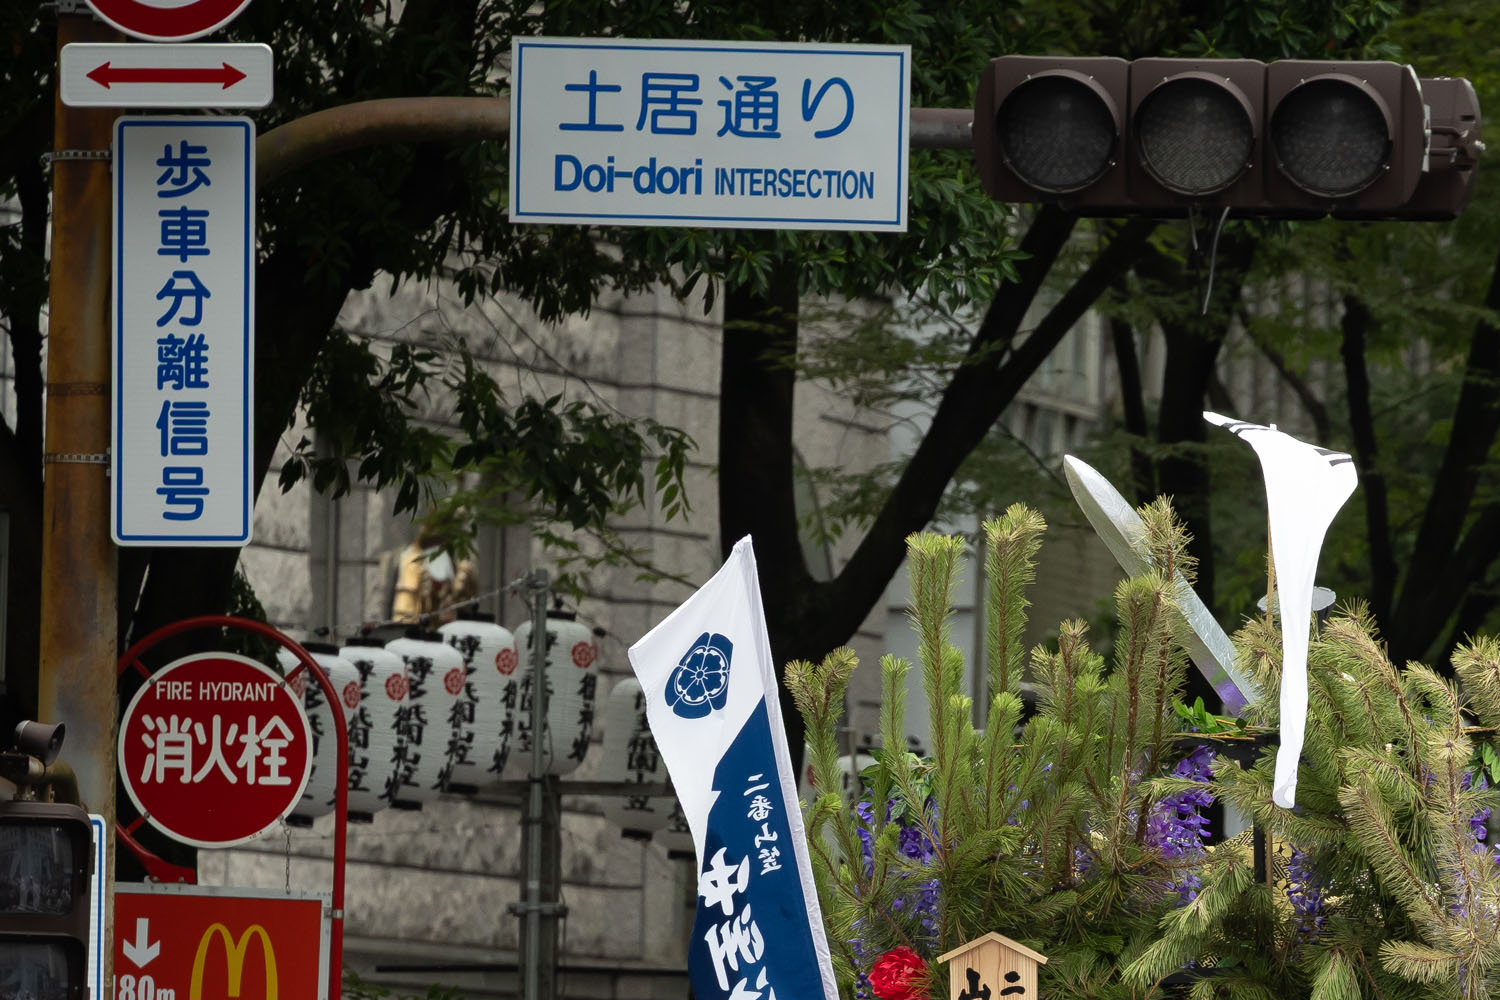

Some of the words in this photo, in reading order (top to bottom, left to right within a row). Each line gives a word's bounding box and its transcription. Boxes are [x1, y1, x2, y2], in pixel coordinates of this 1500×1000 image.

[558, 69, 855, 139] 土居通り
[554, 153, 703, 196] Doi-dori
[714, 167, 875, 200] INTERSECTION
[155, 139, 212, 521] 歩車分離信号
[155, 681, 193, 701] FIRE
[199, 682, 278, 702] HYDRANT
[140, 713, 295, 786] 消火栓
